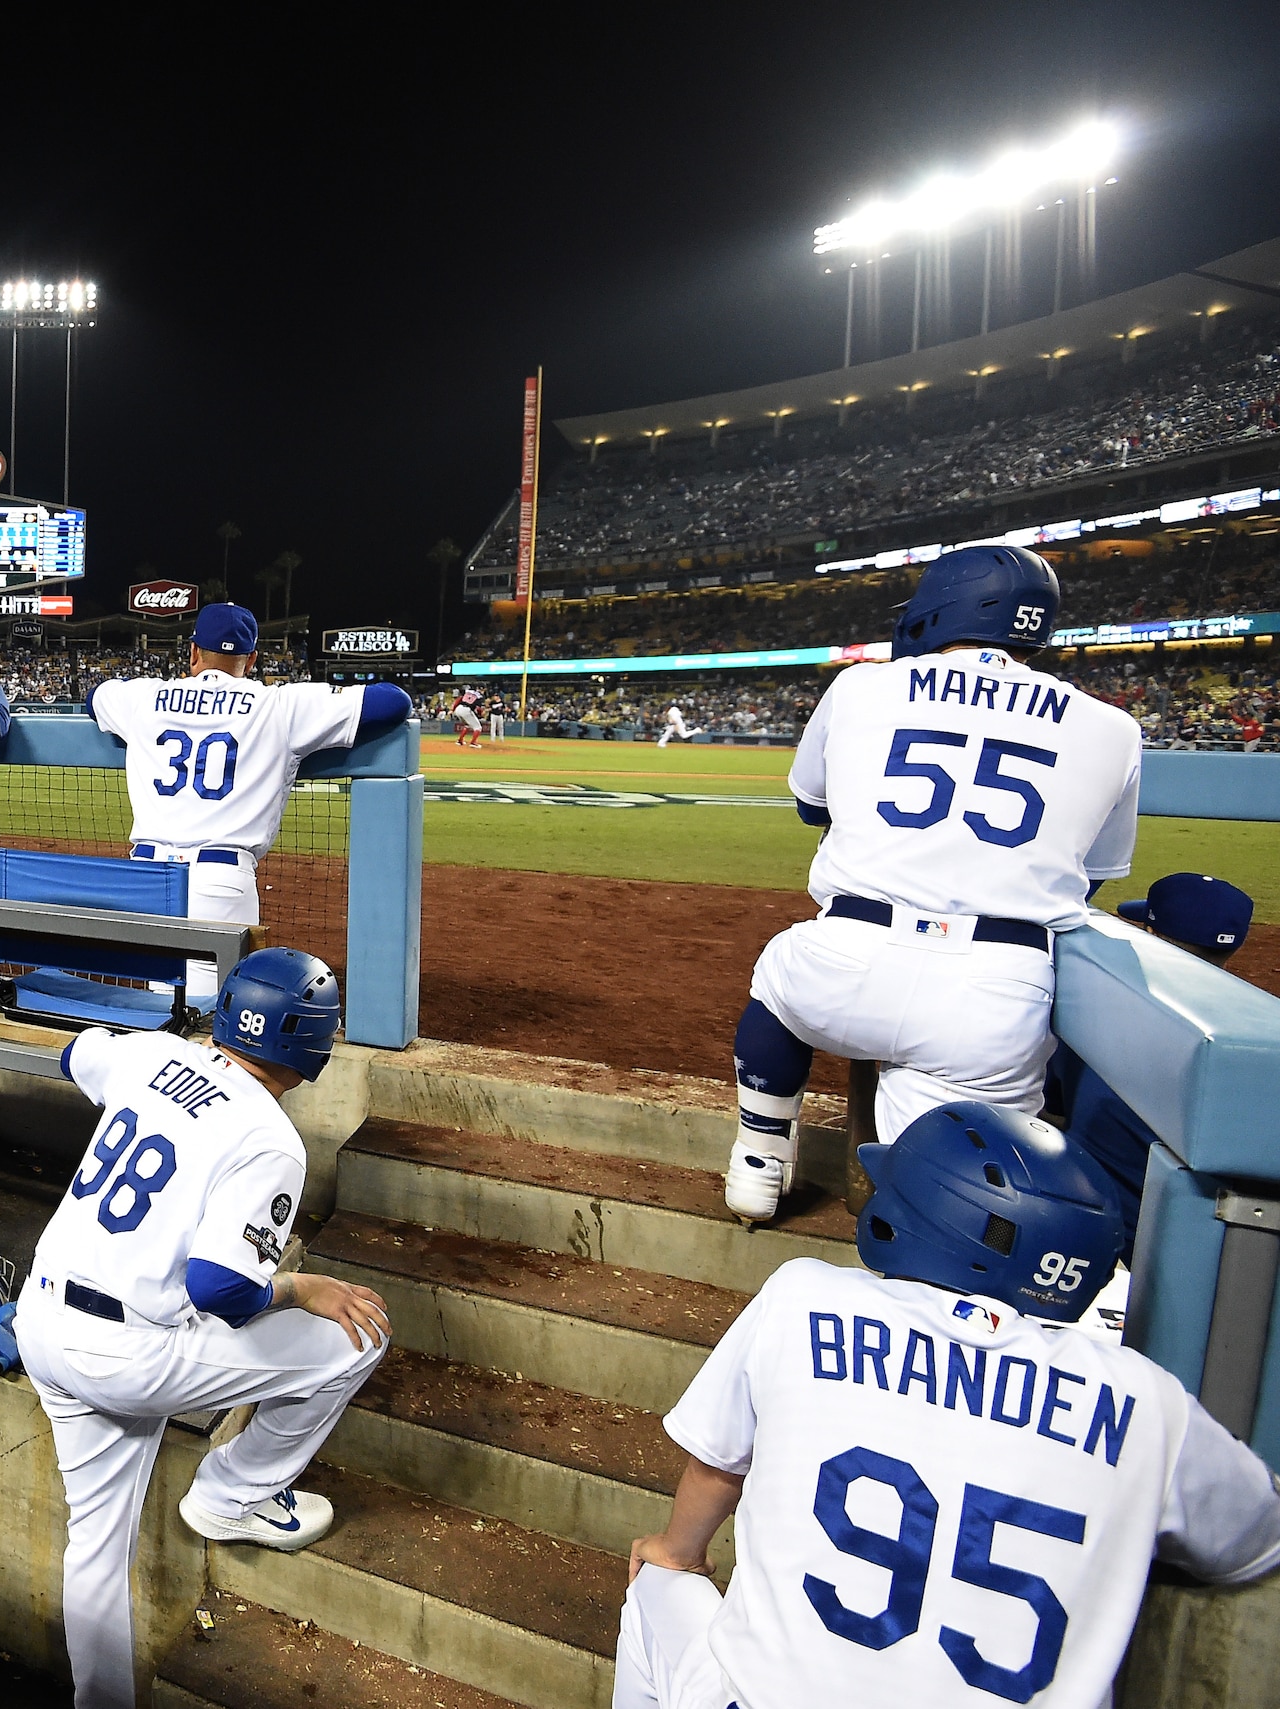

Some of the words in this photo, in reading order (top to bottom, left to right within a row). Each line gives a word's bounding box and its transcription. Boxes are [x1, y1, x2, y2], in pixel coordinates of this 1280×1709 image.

[521, 434, 535, 485] Emirates
[516, 544, 530, 596] Emirates
[1013, 605, 1045, 631] 55
[330, 641, 393, 652] JALISCO
[155, 688, 256, 715] ROBERTS
[909, 668, 1071, 725] MARTIN
[153, 729, 239, 801] 30
[876, 728, 1058, 849] 55
[238, 1009, 266, 1037] 98
[148, 1059, 231, 1119] EDDIE
[71, 1107, 177, 1235] 98
[245, 1228, 281, 1261] POSTSEASON
[1019, 1286, 1070, 1305] POSTSEASON
[1033, 1252, 1090, 1292] 95
[808, 1311, 1136, 1468] BRANDEN
[802, 1446, 1087, 1705] 95
